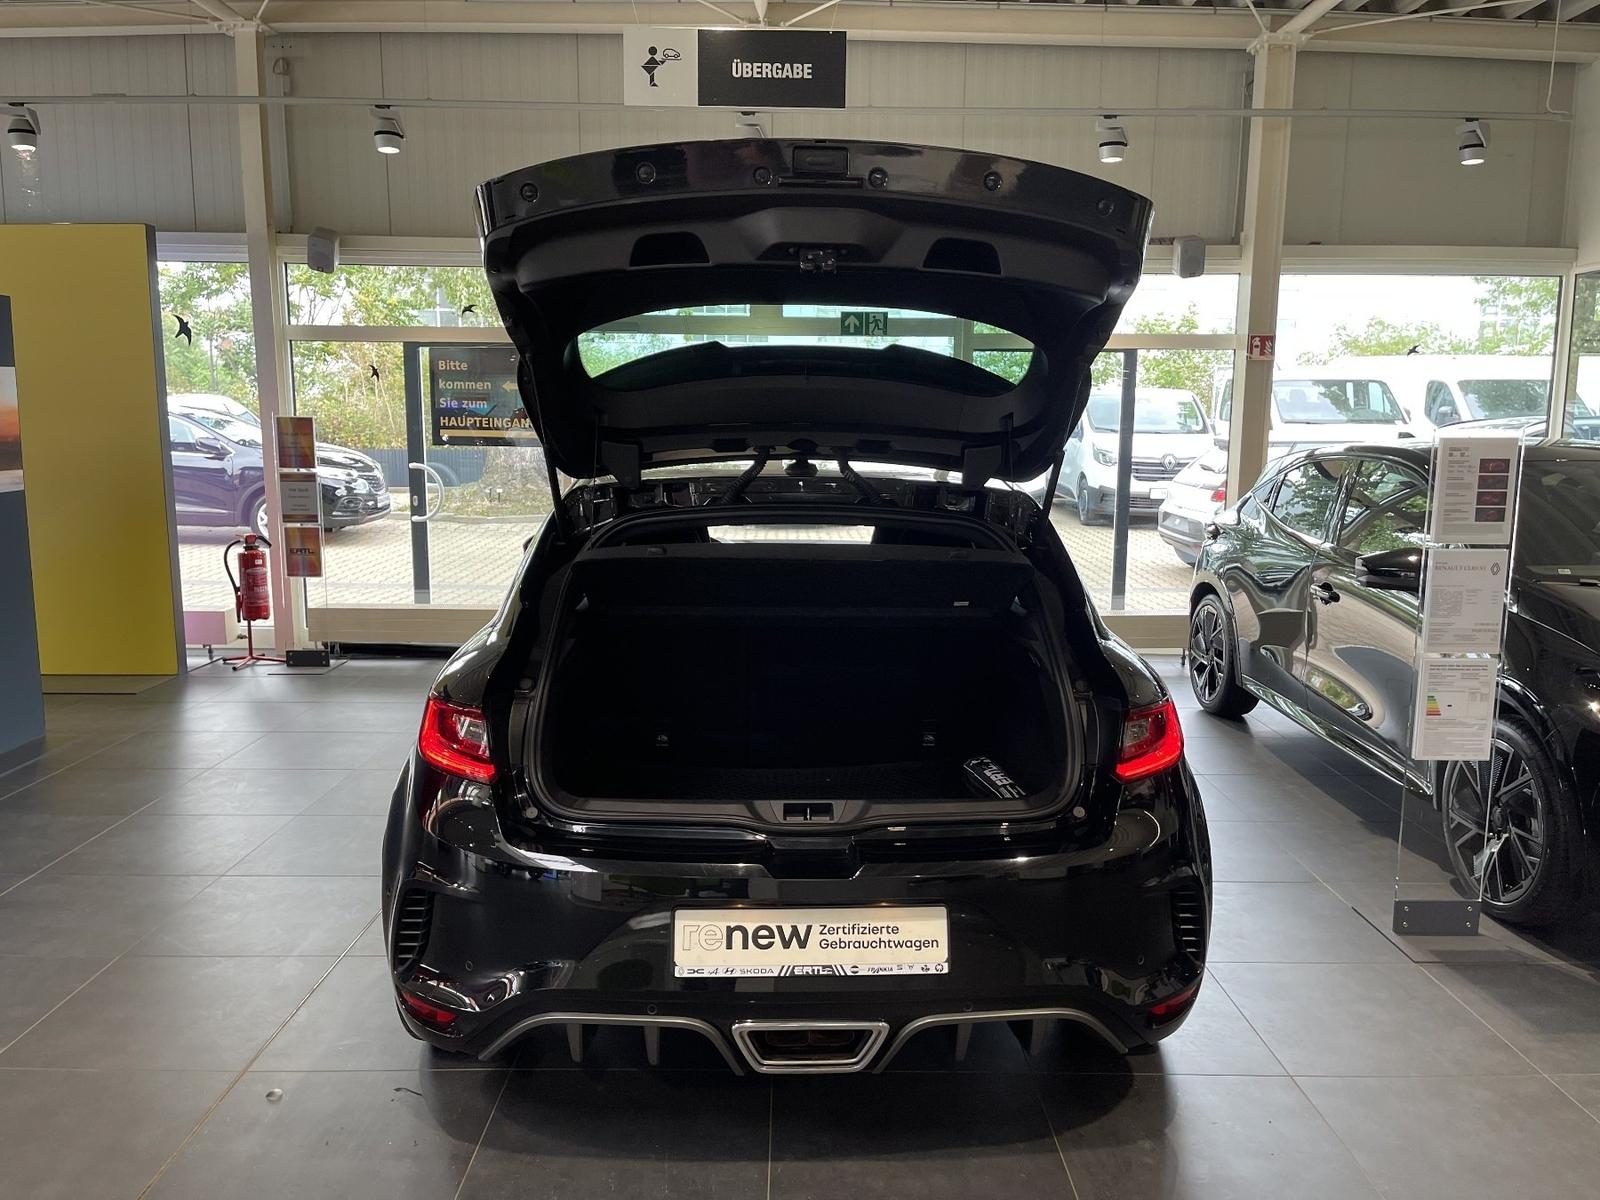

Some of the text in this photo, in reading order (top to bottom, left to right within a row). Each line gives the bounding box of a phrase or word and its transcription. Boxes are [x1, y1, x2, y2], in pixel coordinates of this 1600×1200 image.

[732, 59, 813, 79] ÜBERGABE
[438, 360, 468, 371] Bitte
[439, 379, 492, 390] kommen
[440, 398, 487, 408] Sie zum
[440, 416, 532, 428] HAUPTEINGAN
[819, 923, 900, 935] Zertifizierte
[682, 923, 813, 951] renew
[819, 938, 940, 951] Gebrauchtwagen
